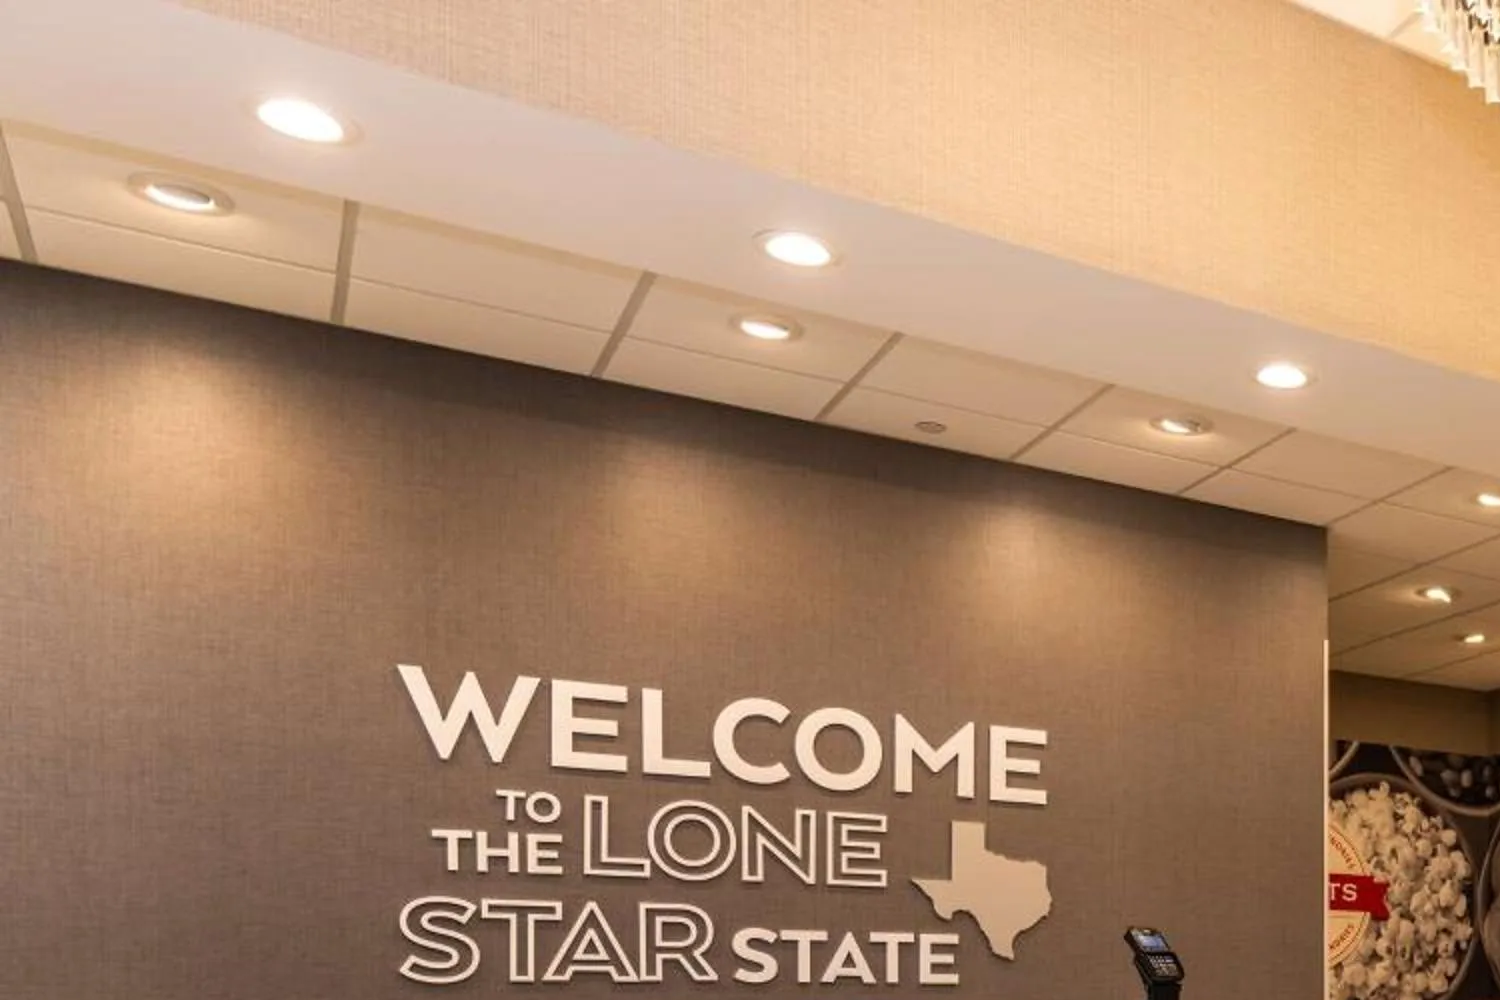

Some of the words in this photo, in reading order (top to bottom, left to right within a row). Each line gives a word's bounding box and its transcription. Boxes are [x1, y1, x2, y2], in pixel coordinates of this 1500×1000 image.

[397, 664, 1048, 805] WELCOME
[431, 829, 562, 875] THE
[583, 795, 888, 888] LONE
[496, 789, 561, 823] TO
[1328, 883, 1357, 902] TS
[399, 896, 718, 984] STAR
[734, 927, 960, 986] STATE
